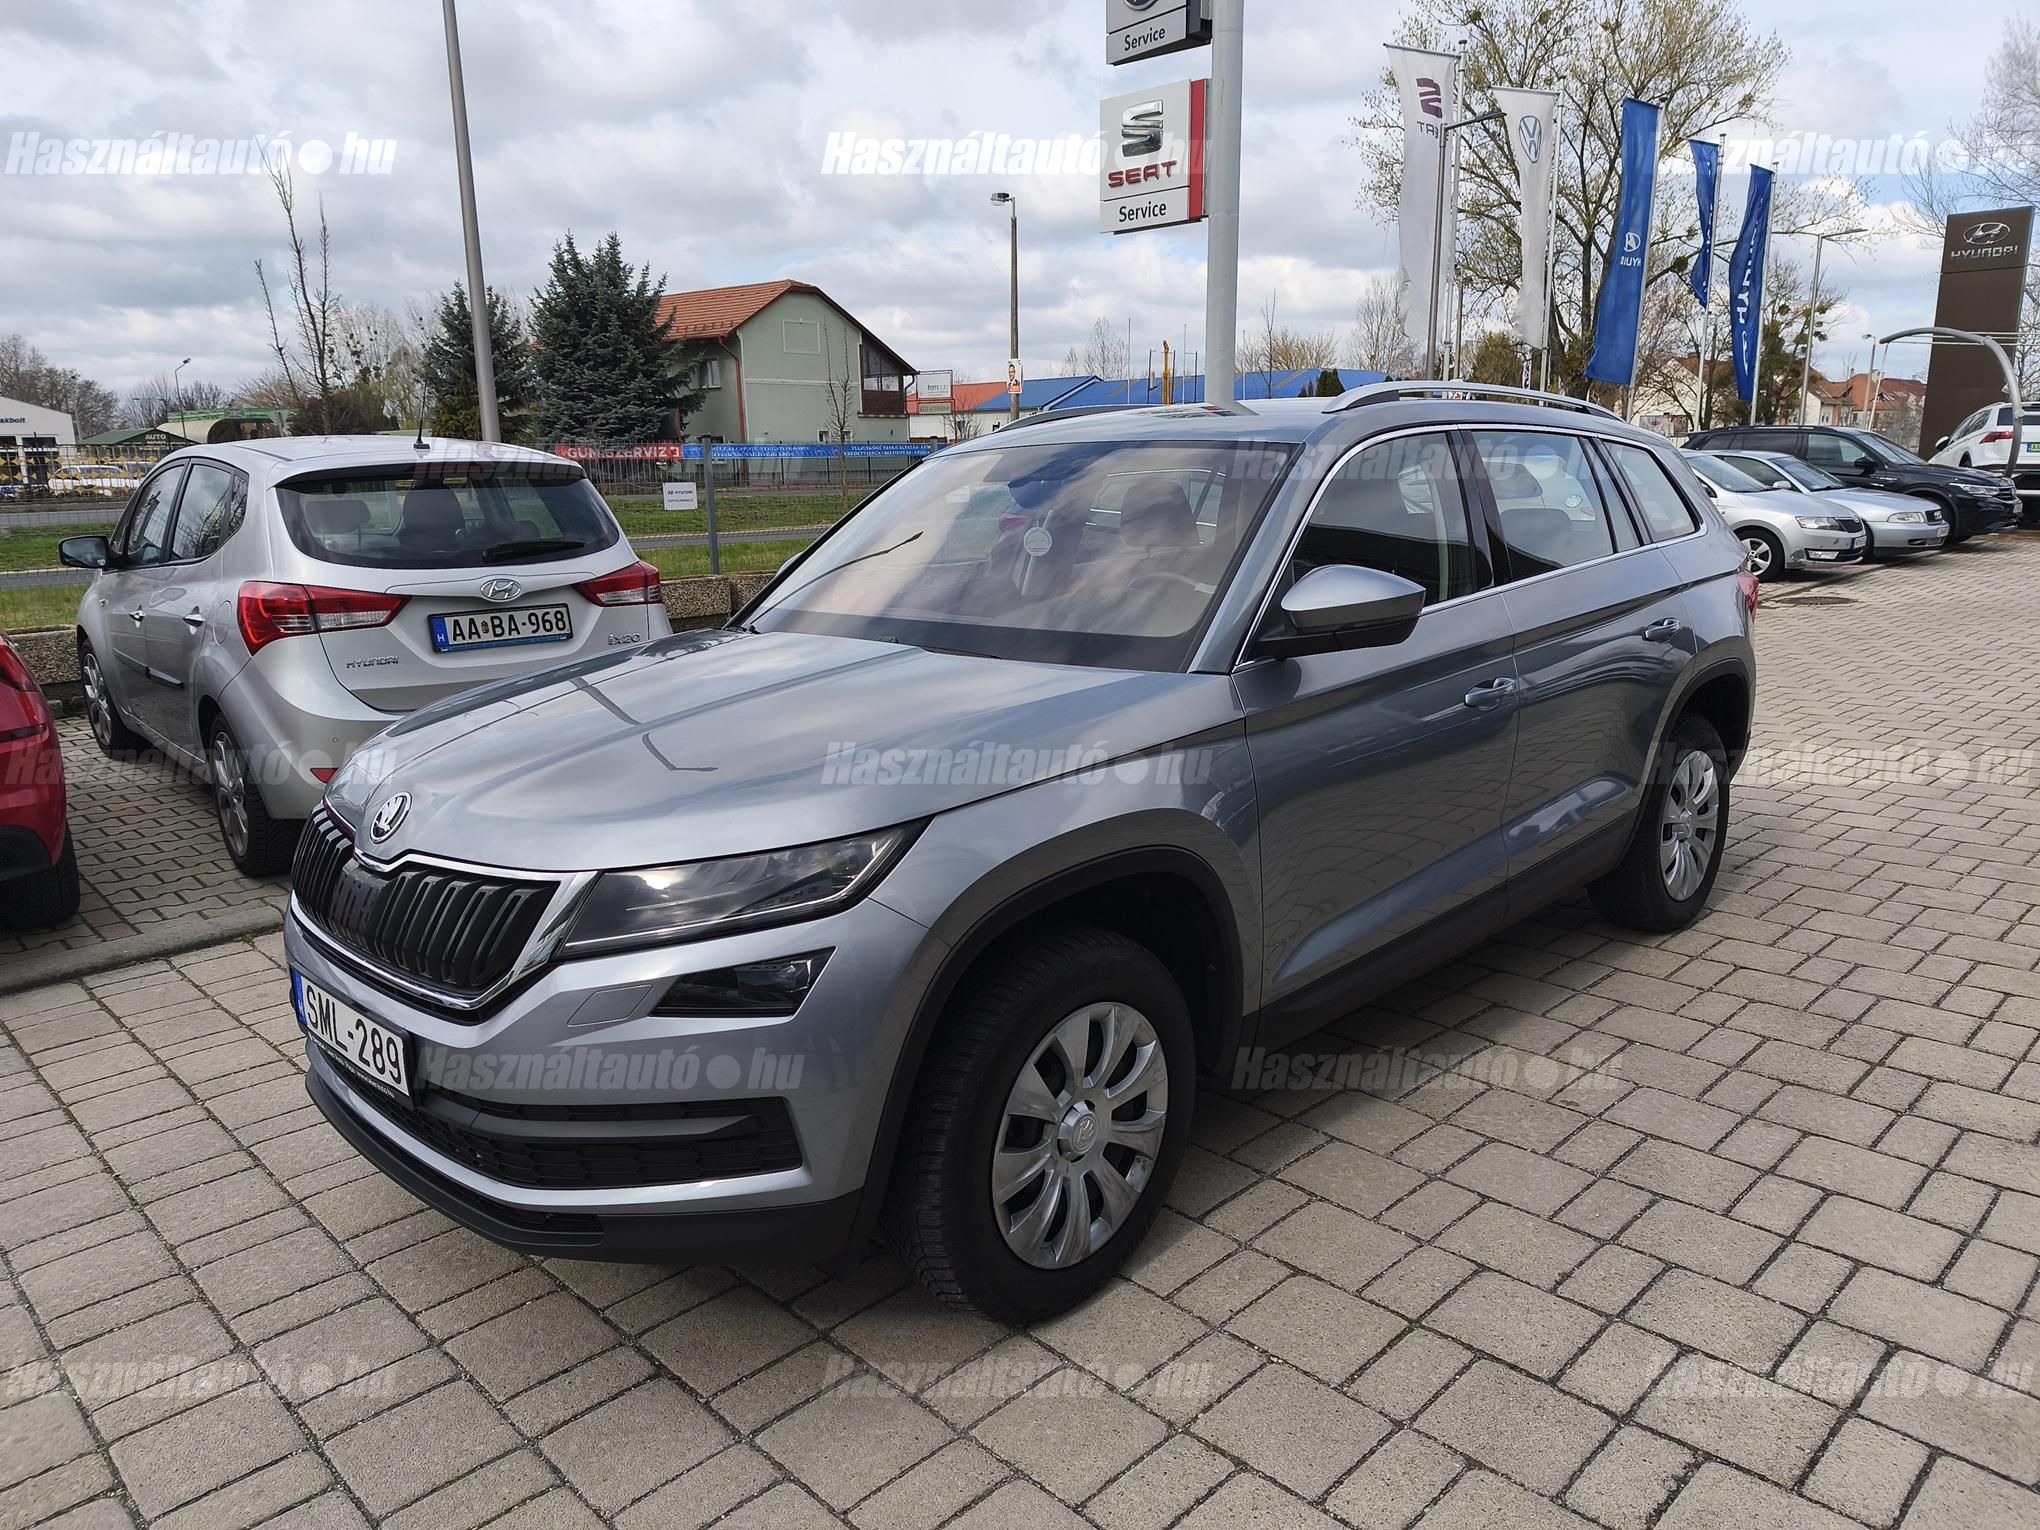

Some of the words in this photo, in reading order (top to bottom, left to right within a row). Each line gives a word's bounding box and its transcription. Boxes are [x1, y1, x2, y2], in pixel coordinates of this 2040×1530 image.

[1124, 27, 1166, 51] Service
[1108, 160, 1177, 188] SEAT
[1118, 201, 1167, 222] Service
[1951, 245, 2019, 260] HYUNDAI
[437, 633, 445, 643] H
[306, 984, 402, 1085] SML-289
